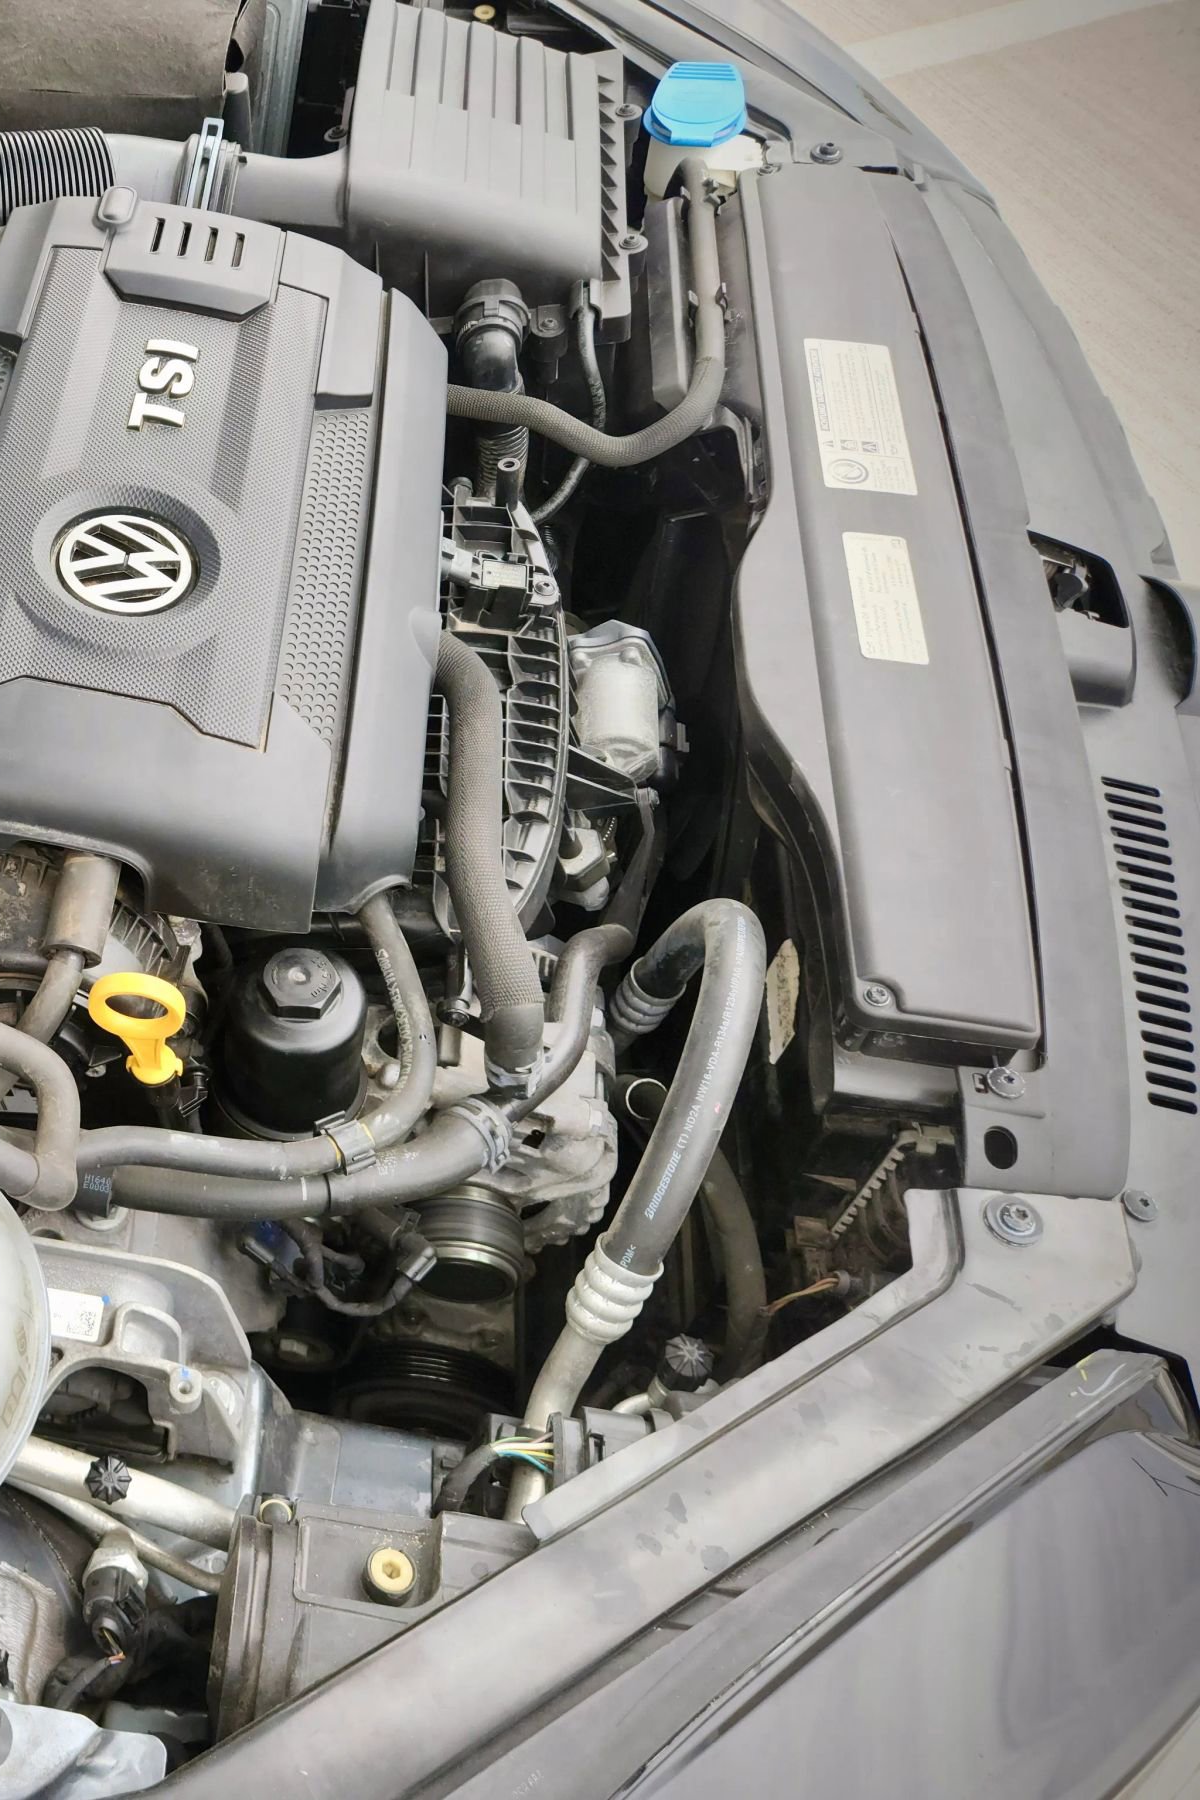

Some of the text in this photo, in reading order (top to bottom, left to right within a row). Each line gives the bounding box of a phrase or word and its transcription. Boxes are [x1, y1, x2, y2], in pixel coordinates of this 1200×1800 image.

[126, 338, 199, 432] TSI
[644, 1149, 682, 1221] BRIDGESTONE
[685, 1104, 701, 1133] ND2A
